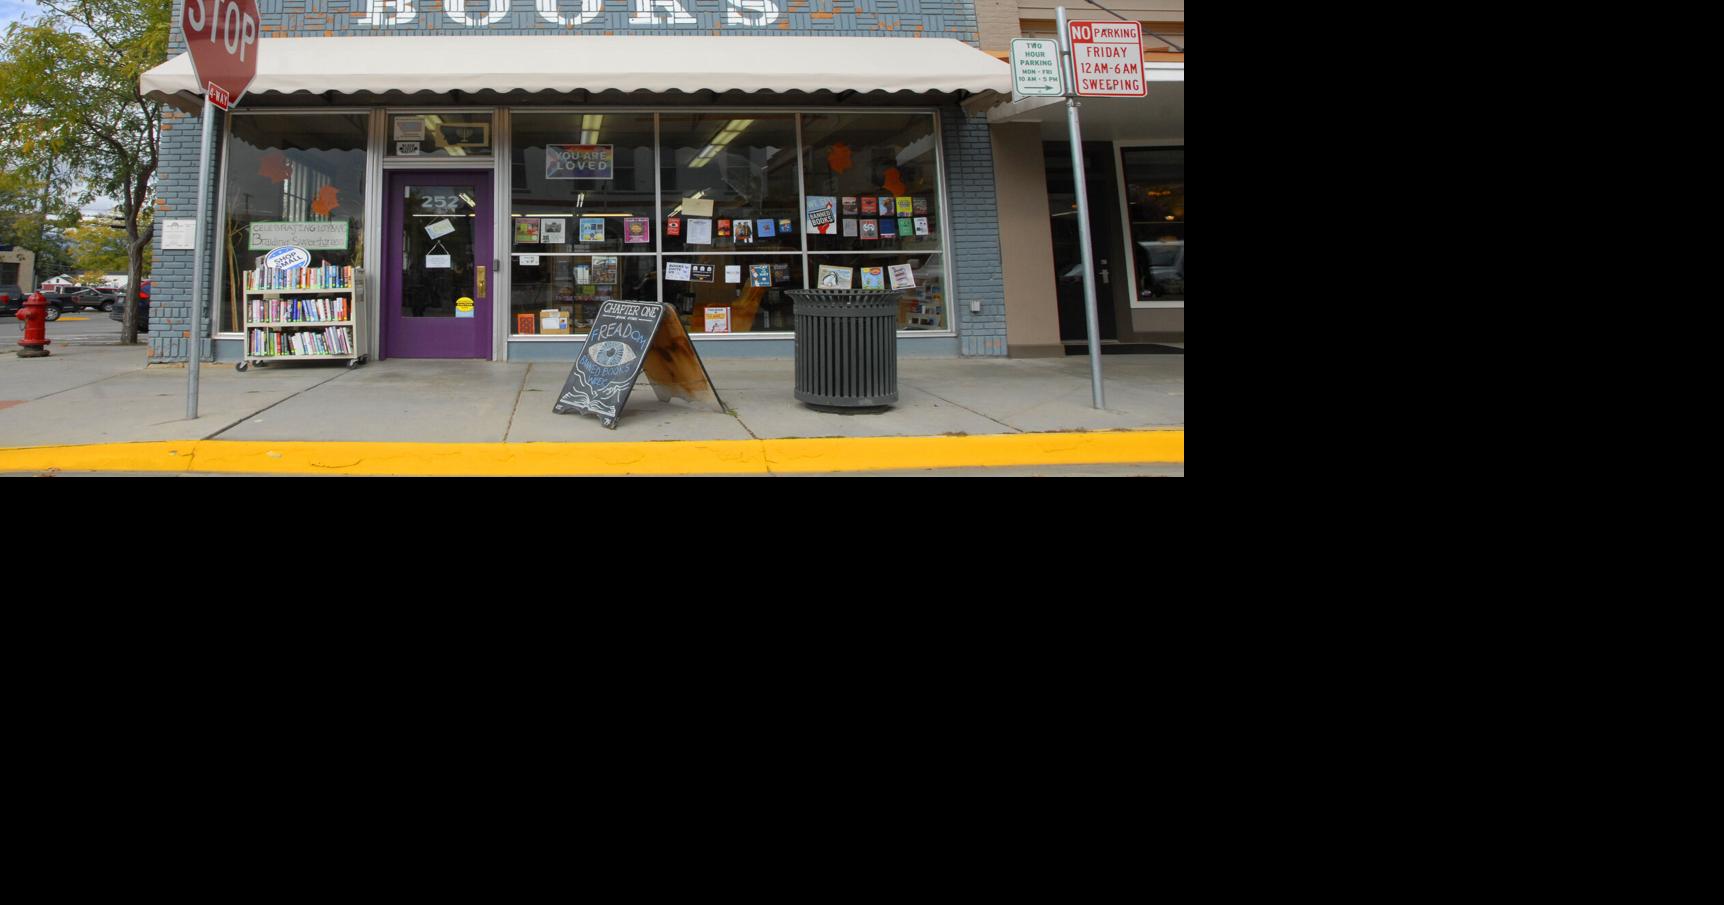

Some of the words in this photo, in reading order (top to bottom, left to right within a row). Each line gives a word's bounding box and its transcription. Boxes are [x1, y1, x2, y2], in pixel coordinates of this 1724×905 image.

[188, 0, 256, 63] STOP
[1071, 26, 1091, 40] NO
[1094, 28, 1137, 39] PARKING
[1086, 46, 1128, 58] FRIDAY
[1082, 78, 1140, 91] SWEEPING
[209, 88, 228, 105] 4-WAY
[556, 151, 579, 160] YOU
[584, 151, 607, 161] ARE
[557, 161, 608, 170] LOVED
[421, 195, 459, 209] 252
[809, 210, 831, 220] BANNED
[812, 215, 834, 226] BOOKS
[273, 251, 297, 264] SHOP
[603, 302, 640, 317] CHAPTER
[641, 306, 660, 319] ONE
